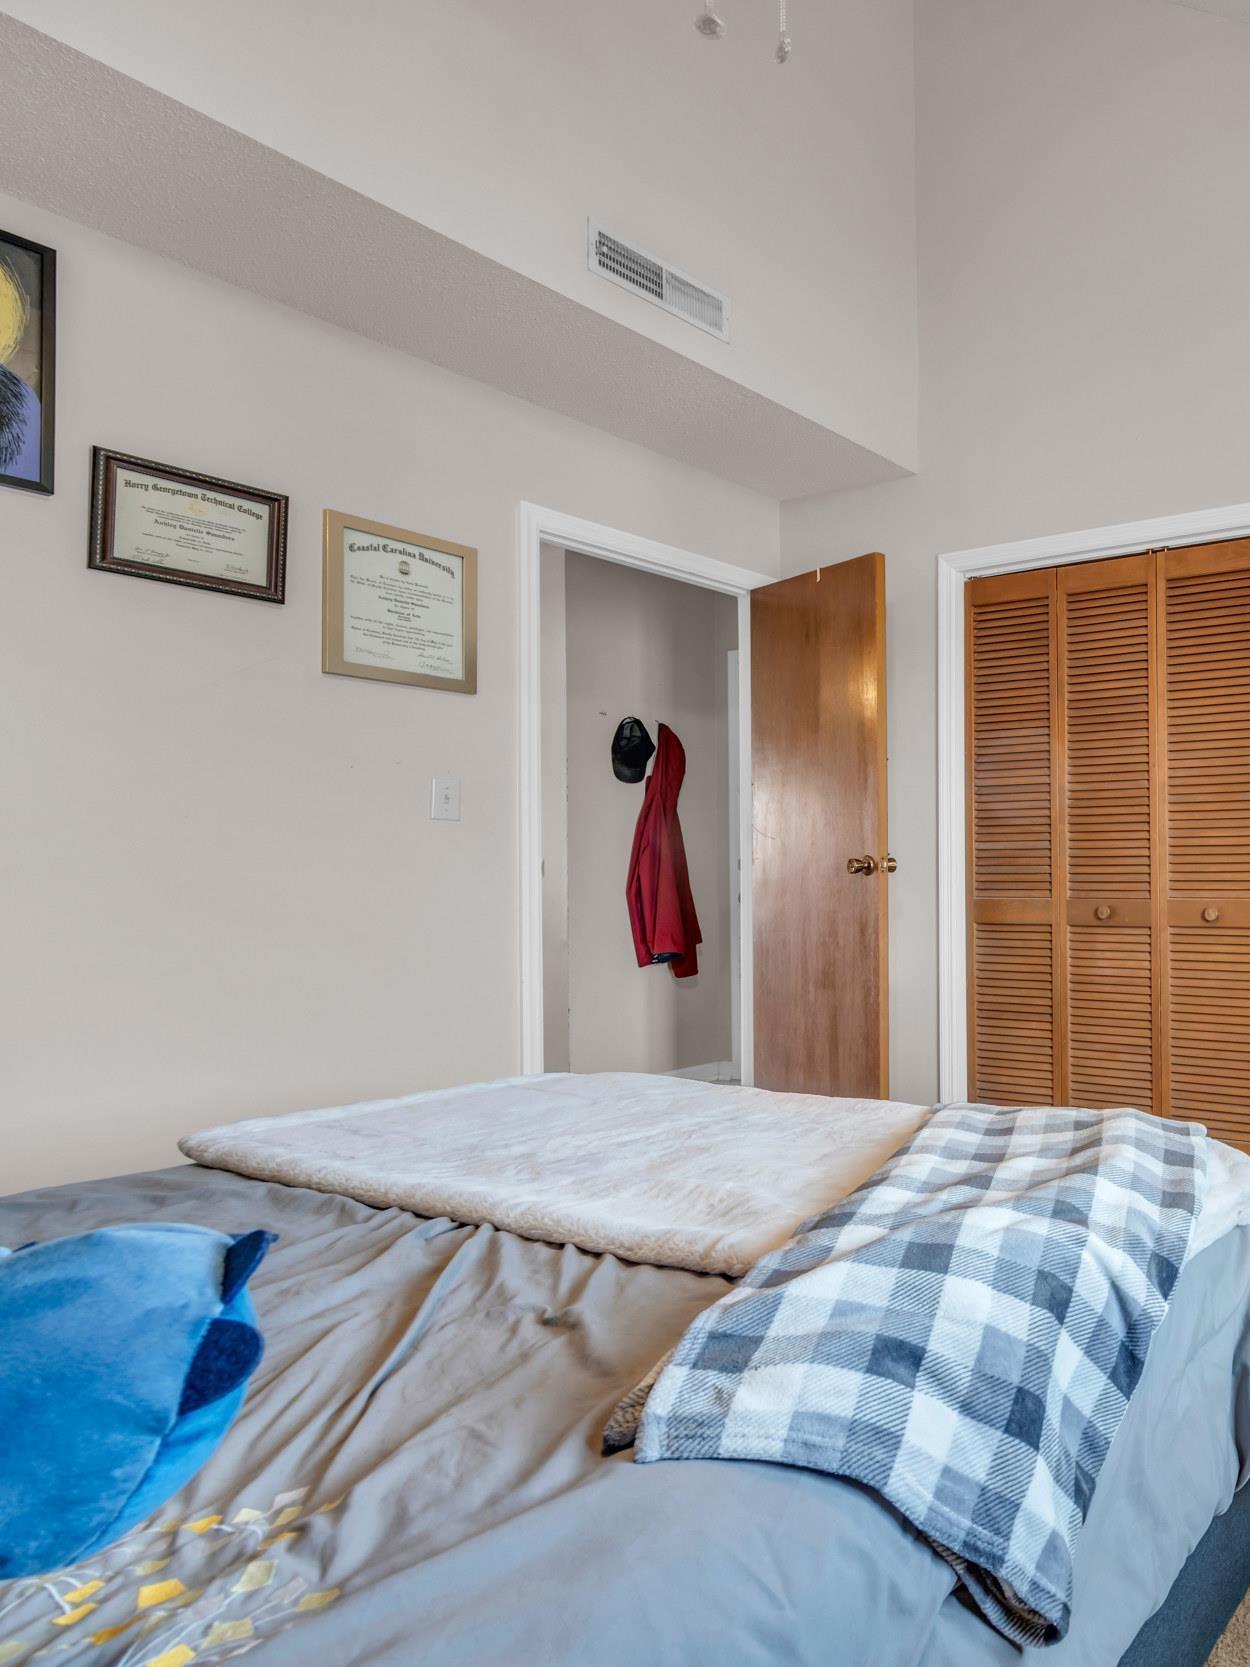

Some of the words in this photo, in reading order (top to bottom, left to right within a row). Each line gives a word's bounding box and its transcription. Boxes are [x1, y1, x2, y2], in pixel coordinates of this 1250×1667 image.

[124, 479, 149, 492] Horry
[151, 483, 199, 500] Georgetown
[200, 493, 235, 511] Technical
[237, 505, 263, 520] College
[349, 542, 380, 553] Coastal
[382, 543, 416, 559] Carolina
[418, 551, 456, 580] University
